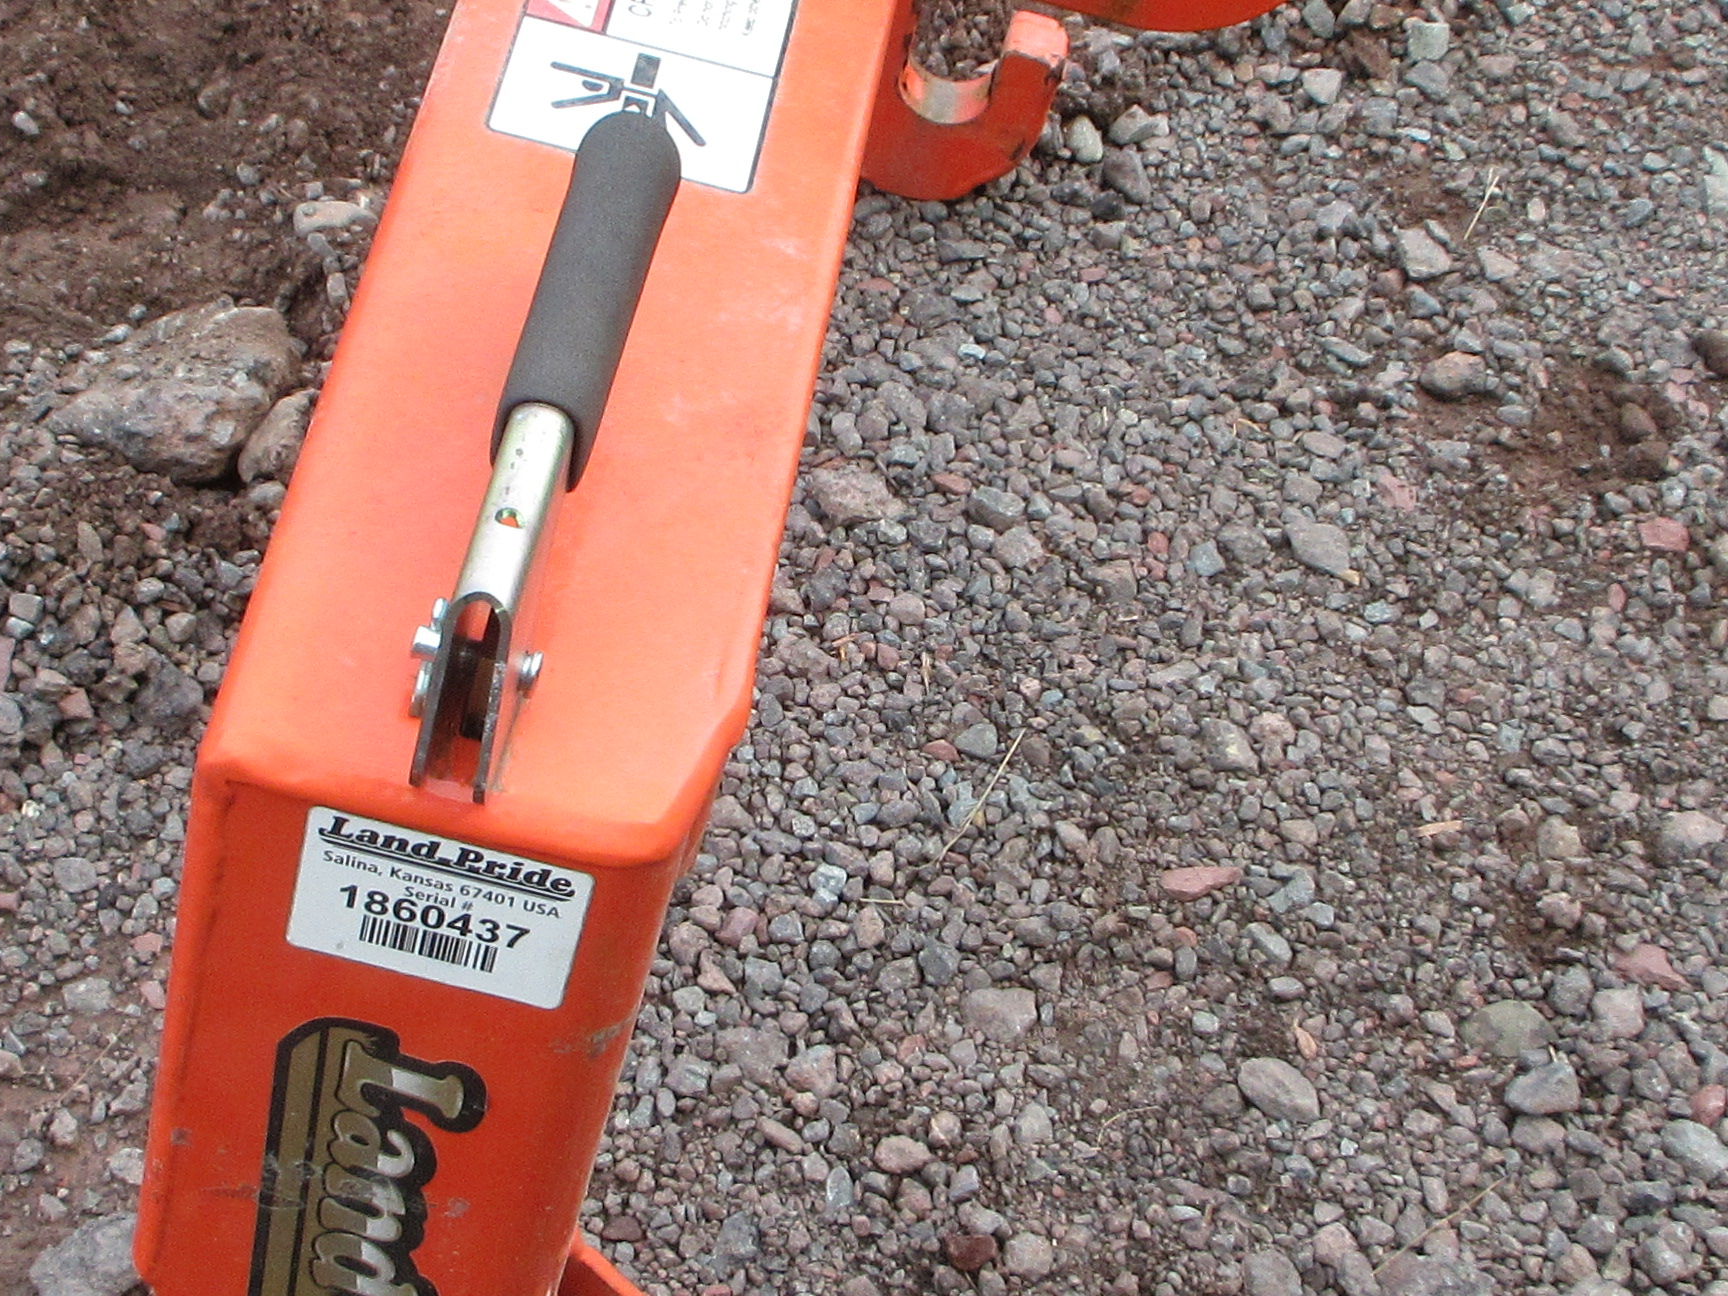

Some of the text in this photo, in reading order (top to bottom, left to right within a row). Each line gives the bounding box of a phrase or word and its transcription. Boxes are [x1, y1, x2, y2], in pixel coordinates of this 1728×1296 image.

[319, 816, 575, 898] Land Pride
[323, 850, 559, 918] Salina, Kansas 67401 USA
[340, 885, 530, 948] 1860437
[404, 886, 456, 908] Serial
